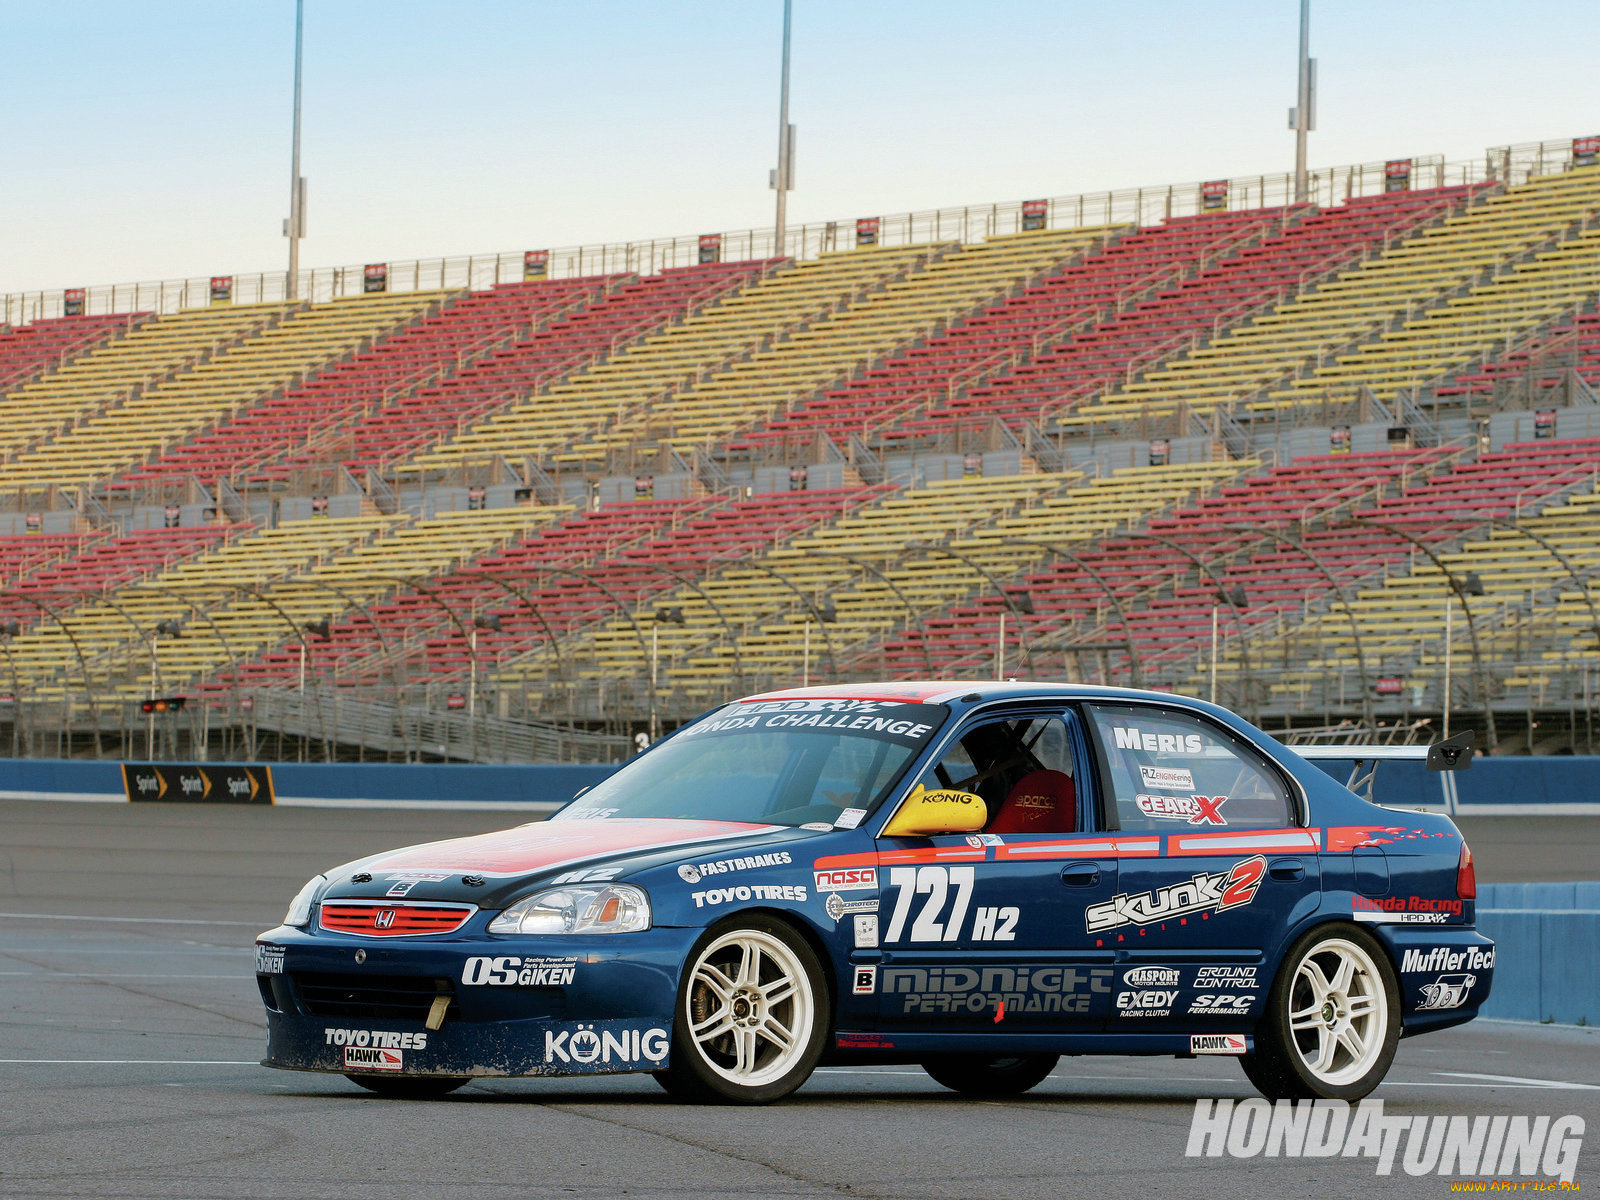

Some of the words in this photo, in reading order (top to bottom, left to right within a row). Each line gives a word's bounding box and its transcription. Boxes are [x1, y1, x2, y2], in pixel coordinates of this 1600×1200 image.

[765, 714, 933, 738] CHALLENGE
[1113, 727, 1202, 753] MERIS
[136, 774, 159, 795] Sprint
[180, 775, 203, 796] Sprint
[227, 777, 250, 797] Sprint
[921, 793, 973, 804] KÖNIG
[700, 851, 793, 877] FASTBRAKES
[550, 867, 624, 885] H2
[816, 870, 875, 886] nasa
[691, 886, 751, 908] TOYO
[751, 885, 808, 902] TIRES
[884, 866, 975, 943] 727
[1351, 895, 1406, 911] Honda
[1408, 895, 1463, 916] Racing
[971, 907, 1020, 941] H2
[1400, 914, 1425, 922] HPD
[1096, 912, 1209, 947] RACING
[461, 956, 521, 986] OS
[518, 968, 576, 986] GIKEN
[857, 972, 873, 986] B
[1131, 970, 1180, 982] HASPORT
[1197, 967, 1257, 977] GROUND
[1193, 978, 1260, 988] CONTROL
[903, 993, 1091, 1013] PERFORMANCE
[1116, 990, 1180, 1010] EXEDY
[1191, 994, 1256, 1008] SPC
[1120, 1010, 1145, 1018] RACING
[1145, 1009, 1171, 1017] CLUTCH
[1187, 1007, 1249, 1015] PERFORMANCE
[324, 1028, 370, 1047] TOYO
[371, 1030, 427, 1050] TIRES
[545, 1023, 670, 1063] KÖNIG
[1191, 1036, 1228, 1049] HAWK
[346, 1048, 382, 1063] HAWK
